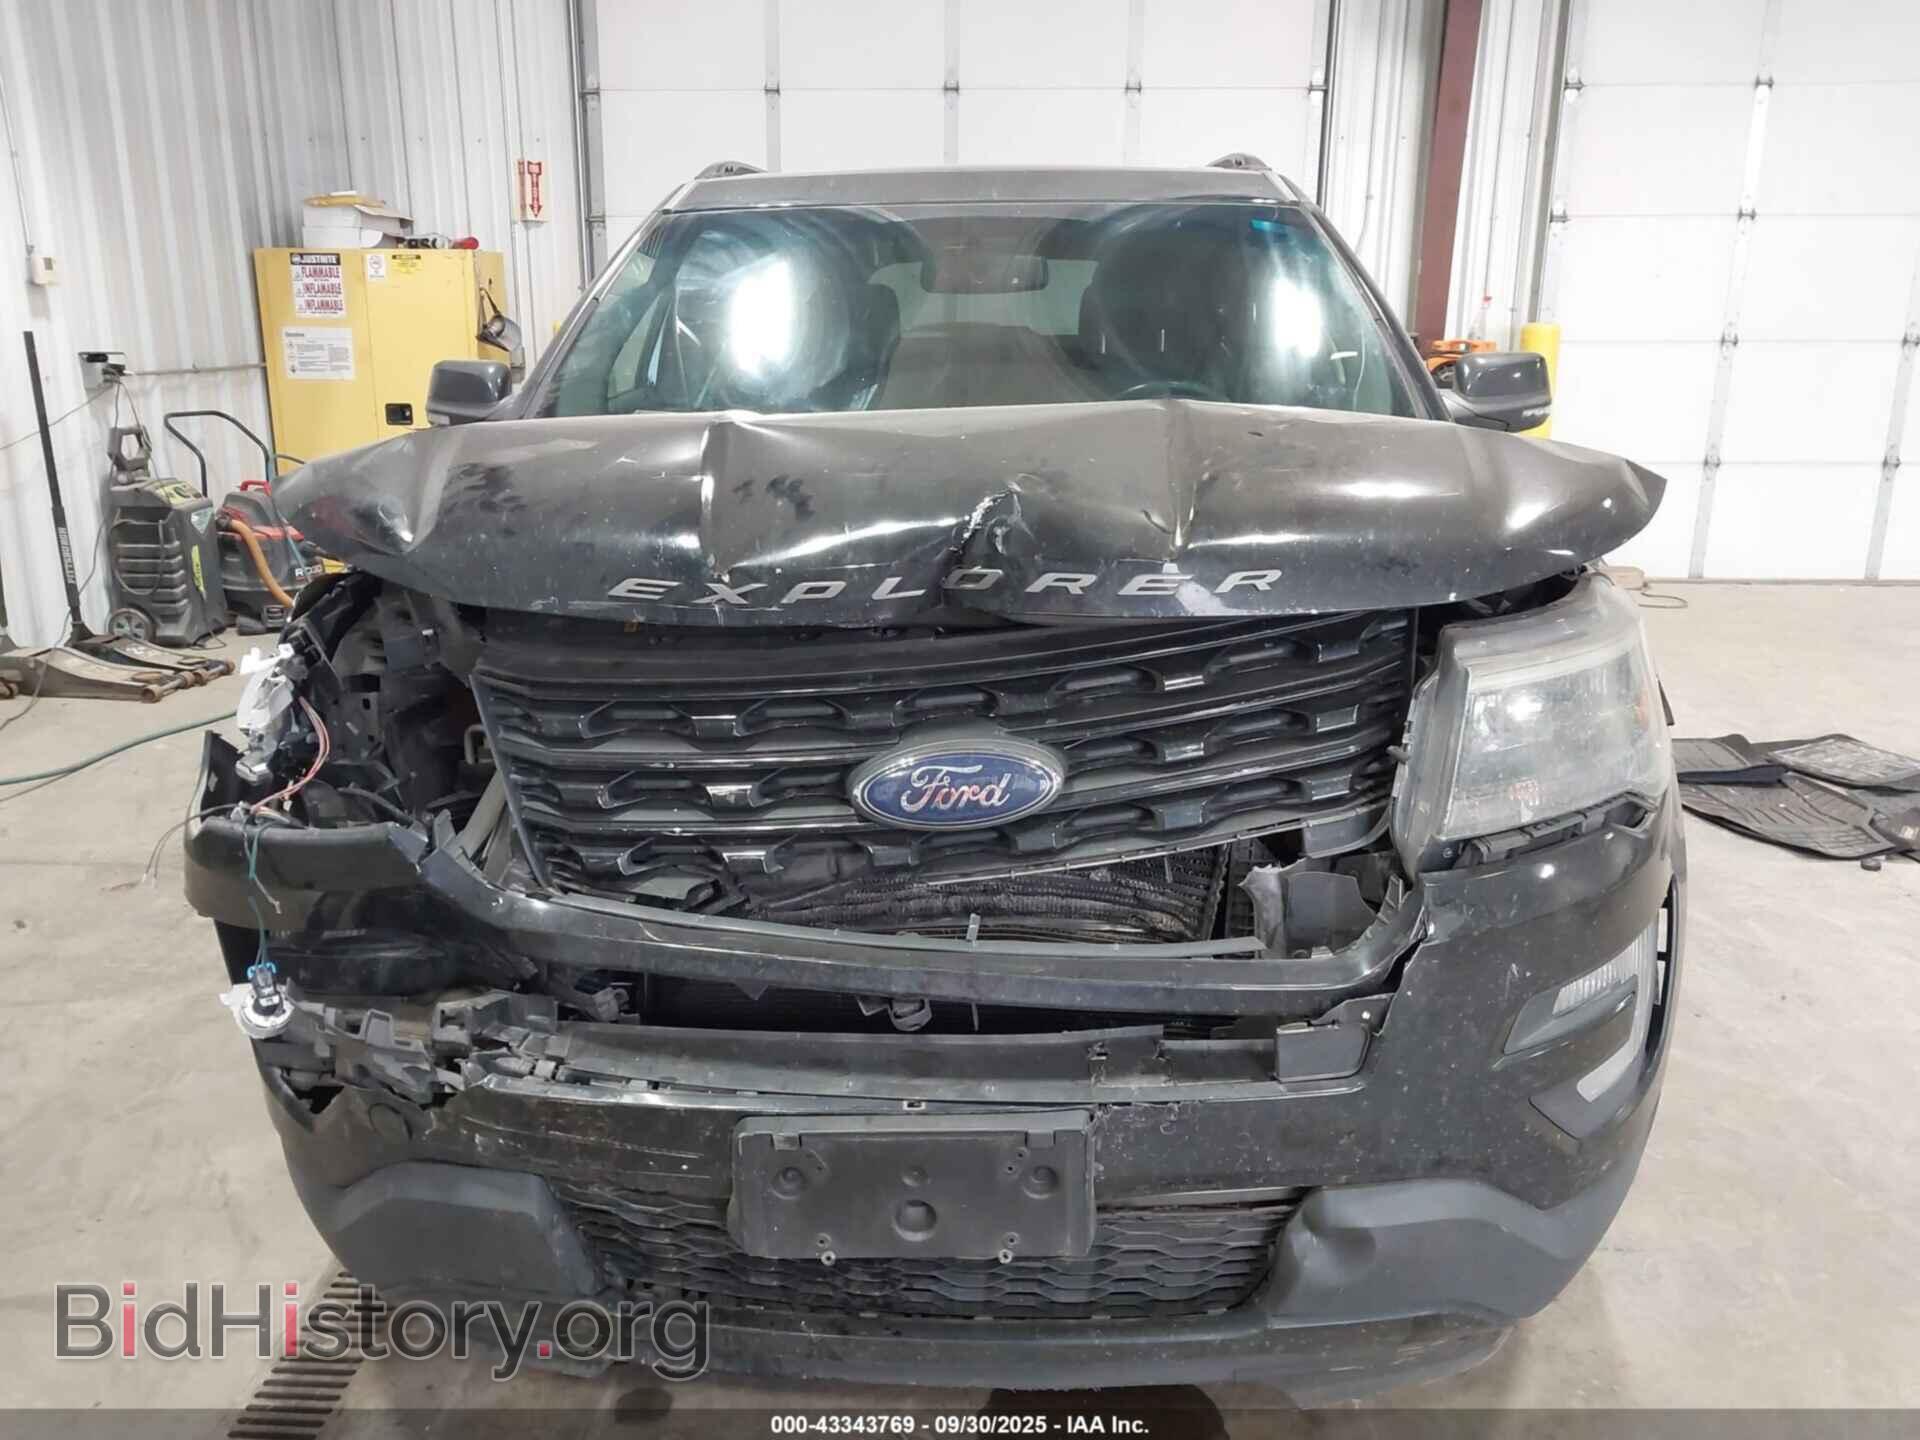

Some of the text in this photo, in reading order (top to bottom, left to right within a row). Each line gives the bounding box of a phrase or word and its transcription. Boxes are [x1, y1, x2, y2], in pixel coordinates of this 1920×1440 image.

[301, 266, 340, 278] FLAMMABLE
[607, 567, 1282, 604] EXPLORER
[900, 764, 1012, 813] Ford
